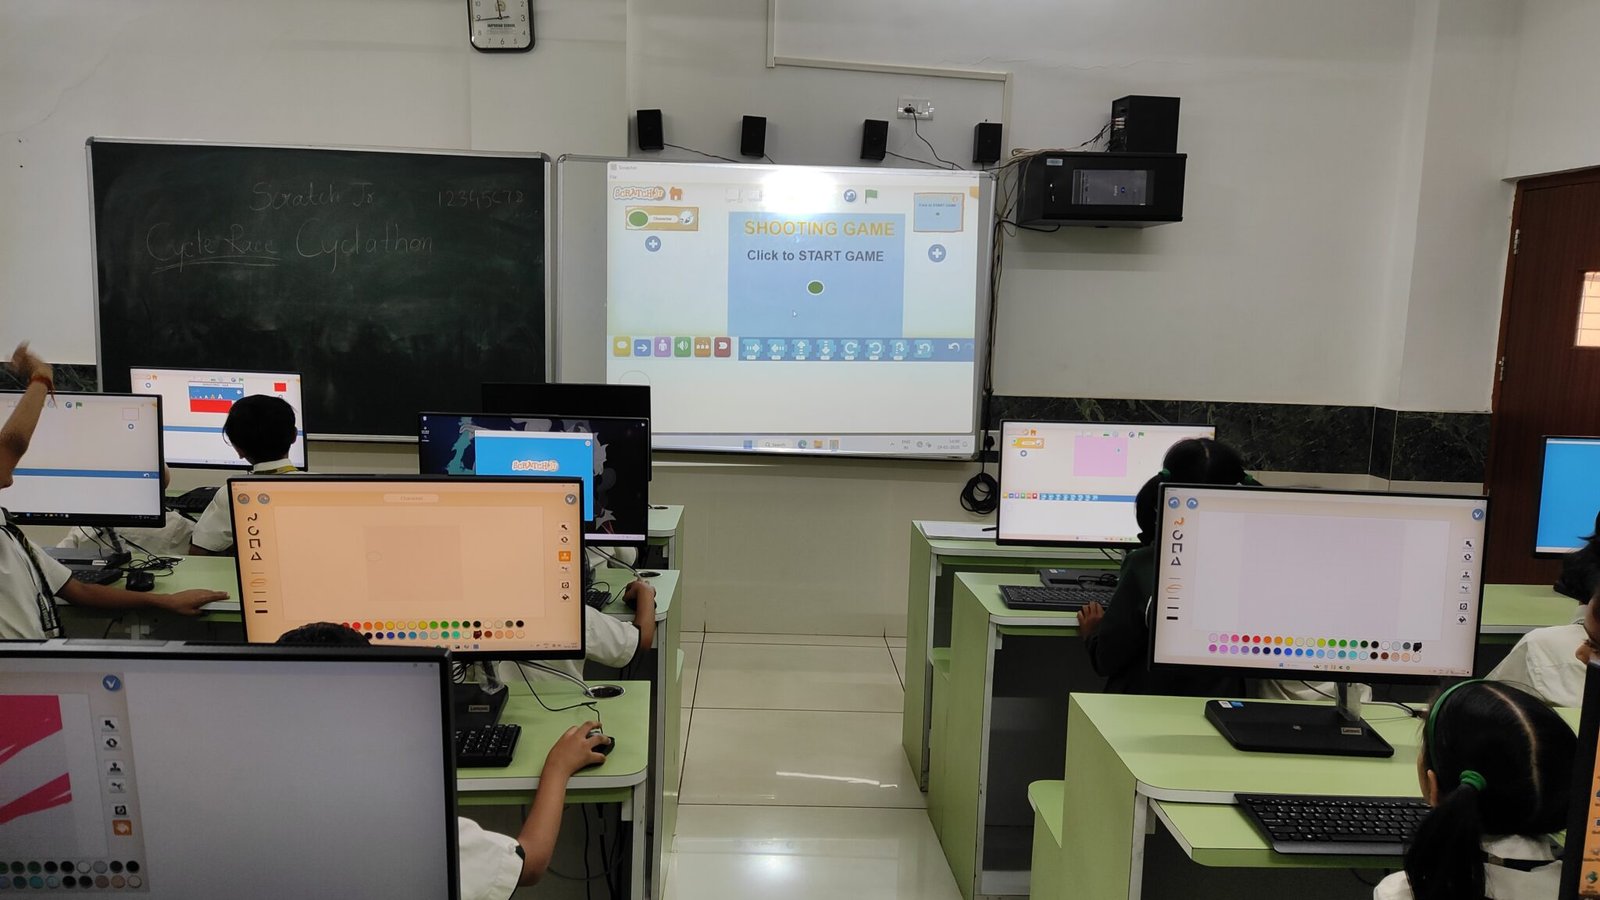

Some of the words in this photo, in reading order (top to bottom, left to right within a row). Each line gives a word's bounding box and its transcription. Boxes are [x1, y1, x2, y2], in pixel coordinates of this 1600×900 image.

[249, 181, 342, 211] Scratch
[745, 221, 837, 236] SHOOTING
[843, 221, 895, 236] GAME
[146, 223, 216, 272] Cycle
[747, 250, 778, 261] Click
[782, 250, 795, 261] to
[798, 250, 842, 261] START
[845, 250, 884, 262] GAME
